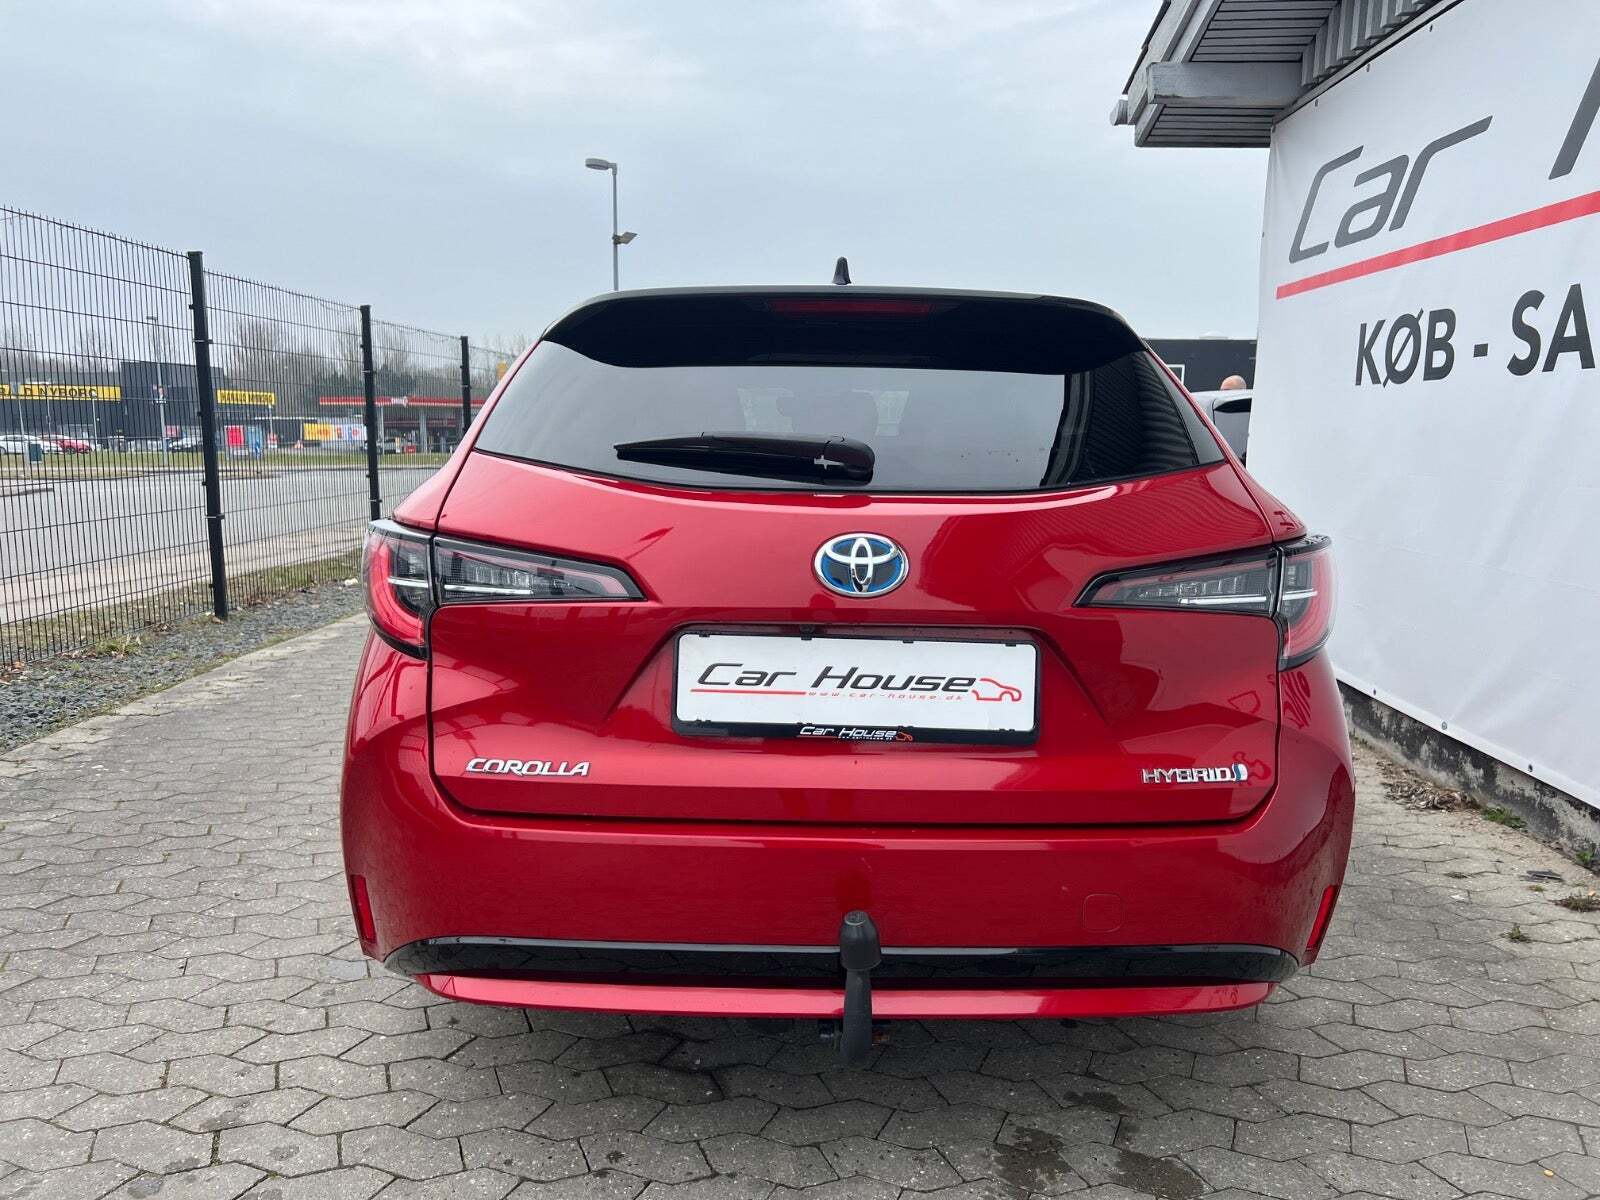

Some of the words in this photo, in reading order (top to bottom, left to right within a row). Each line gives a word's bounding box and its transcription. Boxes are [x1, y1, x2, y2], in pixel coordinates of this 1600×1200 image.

[1288, 115, 1493, 264] Car
[1355, 308, 1456, 388] KØB
[697, 663, 797, 687] Car
[810, 665, 977, 692] House
[800, 726, 835, 736] Car
[838, 727, 897, 738] House
[465, 758, 590, 776] COROLLA
[1142, 767, 1235, 783] HYBRID
